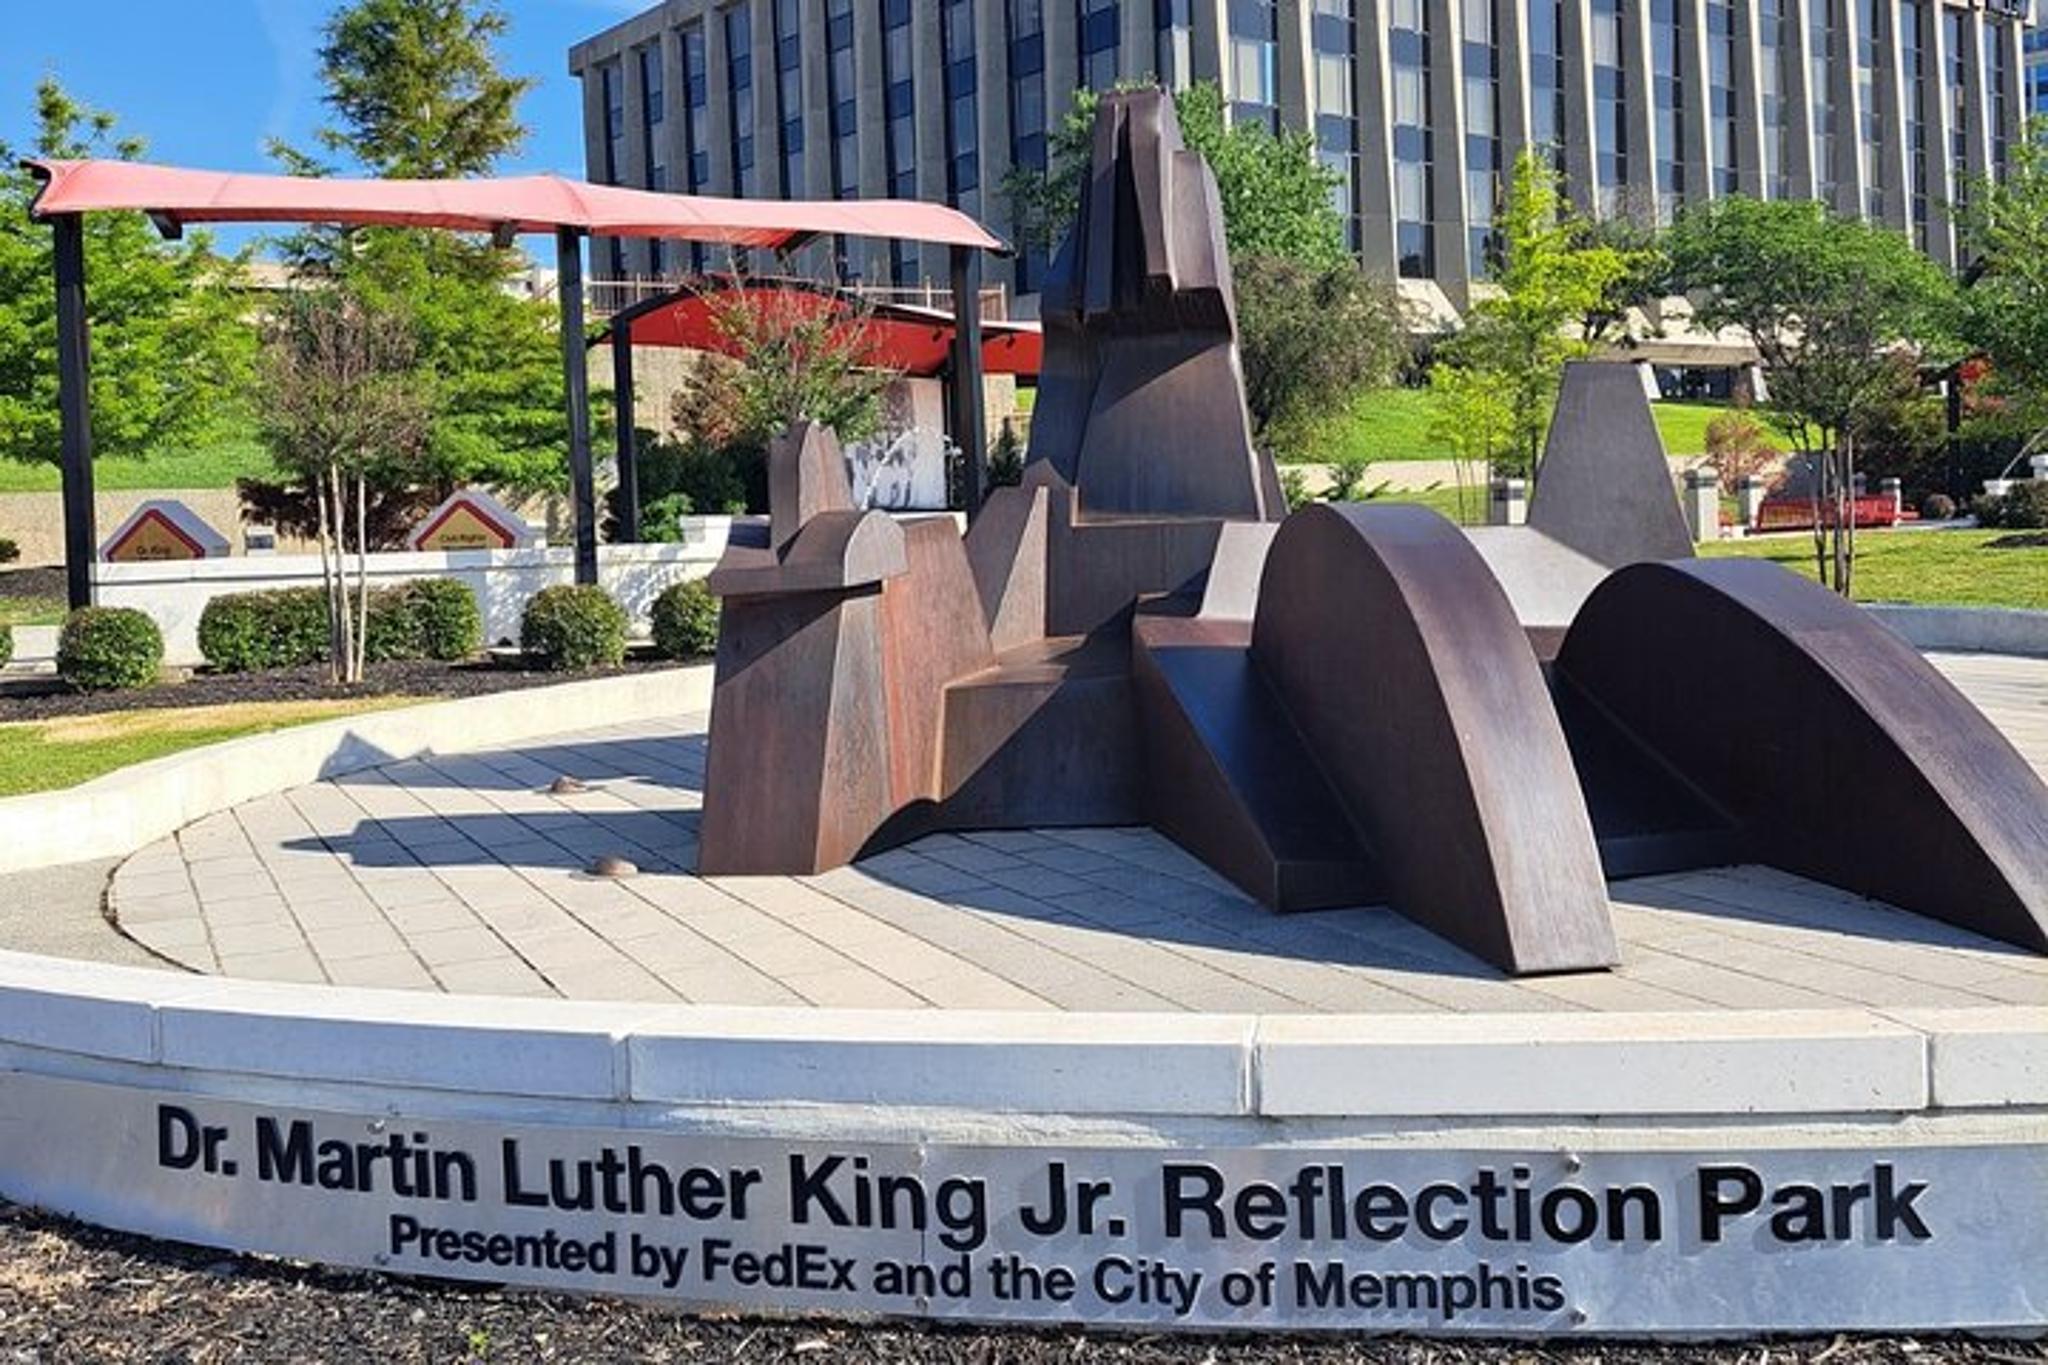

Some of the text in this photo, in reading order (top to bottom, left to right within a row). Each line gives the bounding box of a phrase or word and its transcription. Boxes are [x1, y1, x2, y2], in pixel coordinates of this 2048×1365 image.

[158, 1103, 1932, 1253] Dr. Martin Luther King Jr. Reflection Park
[389, 1213, 1565, 1320] Presented by FedEx and the City of Memphis
